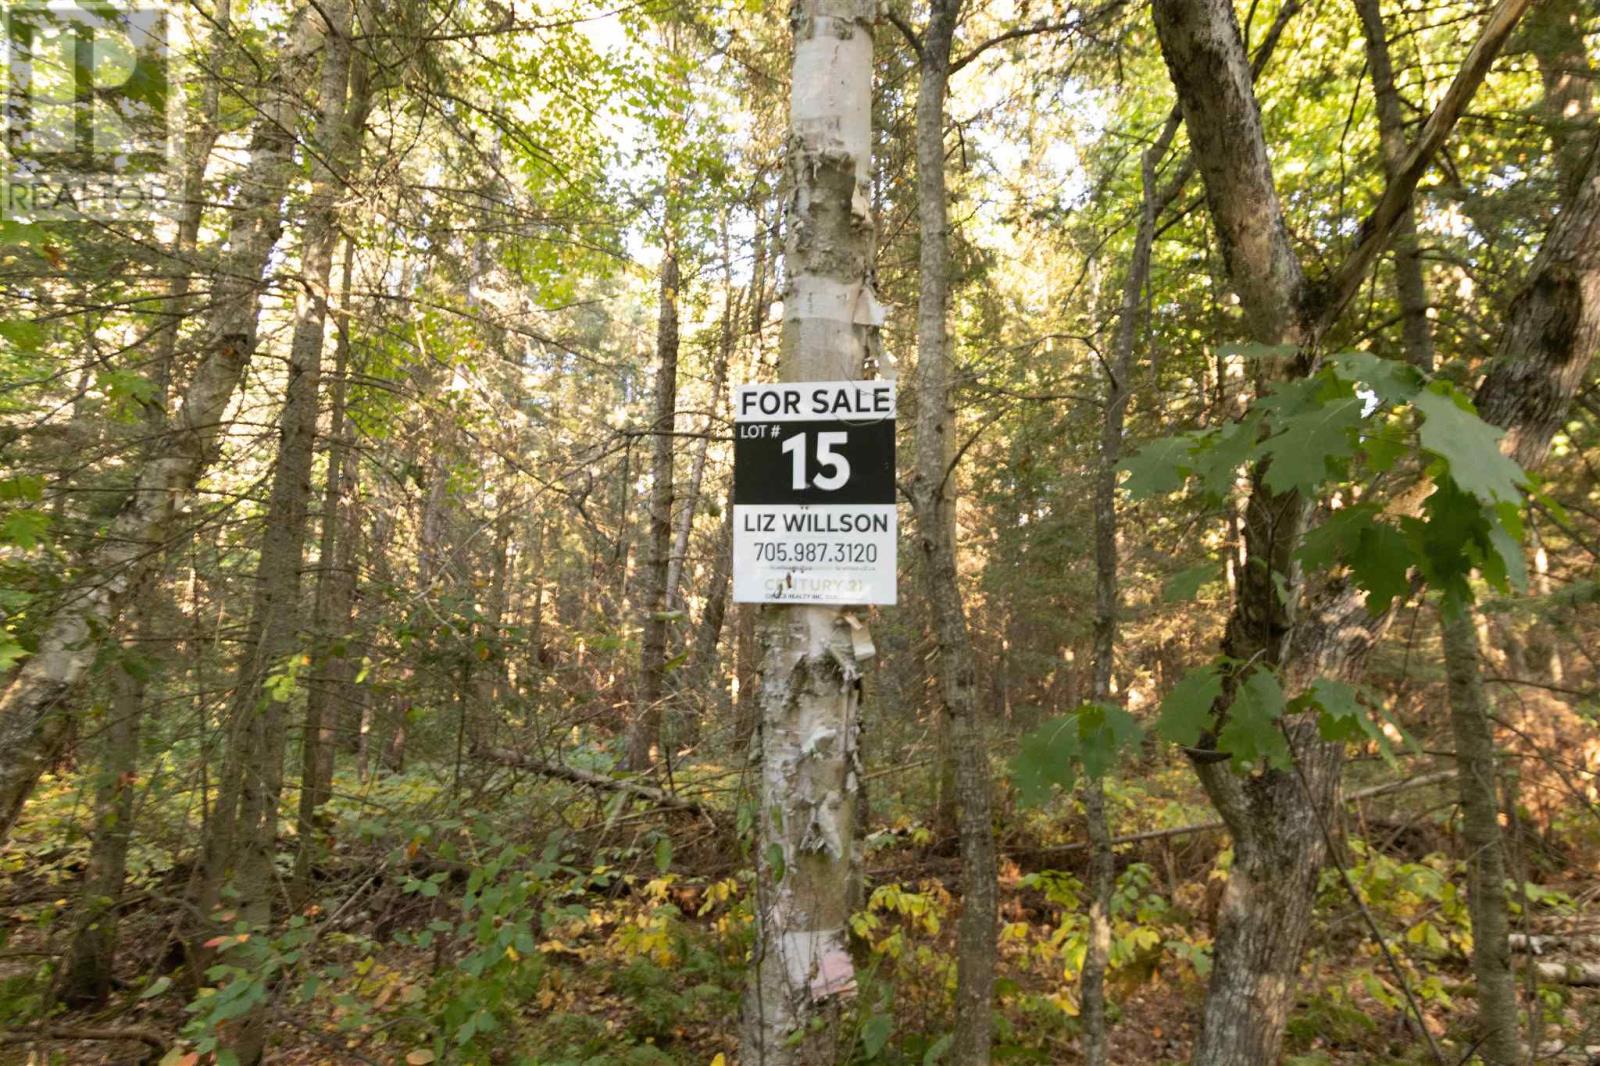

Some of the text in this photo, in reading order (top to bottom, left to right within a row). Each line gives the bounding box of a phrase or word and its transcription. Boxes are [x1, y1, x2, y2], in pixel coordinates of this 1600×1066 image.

[742, 387, 890, 415] FOR SALE
[740, 425, 768, 439] LOT
[782, 431, 851, 491] 15
[744, 513, 888, 533] LIZ WILLSON
[754, 542, 877, 563] 705.987.3120
